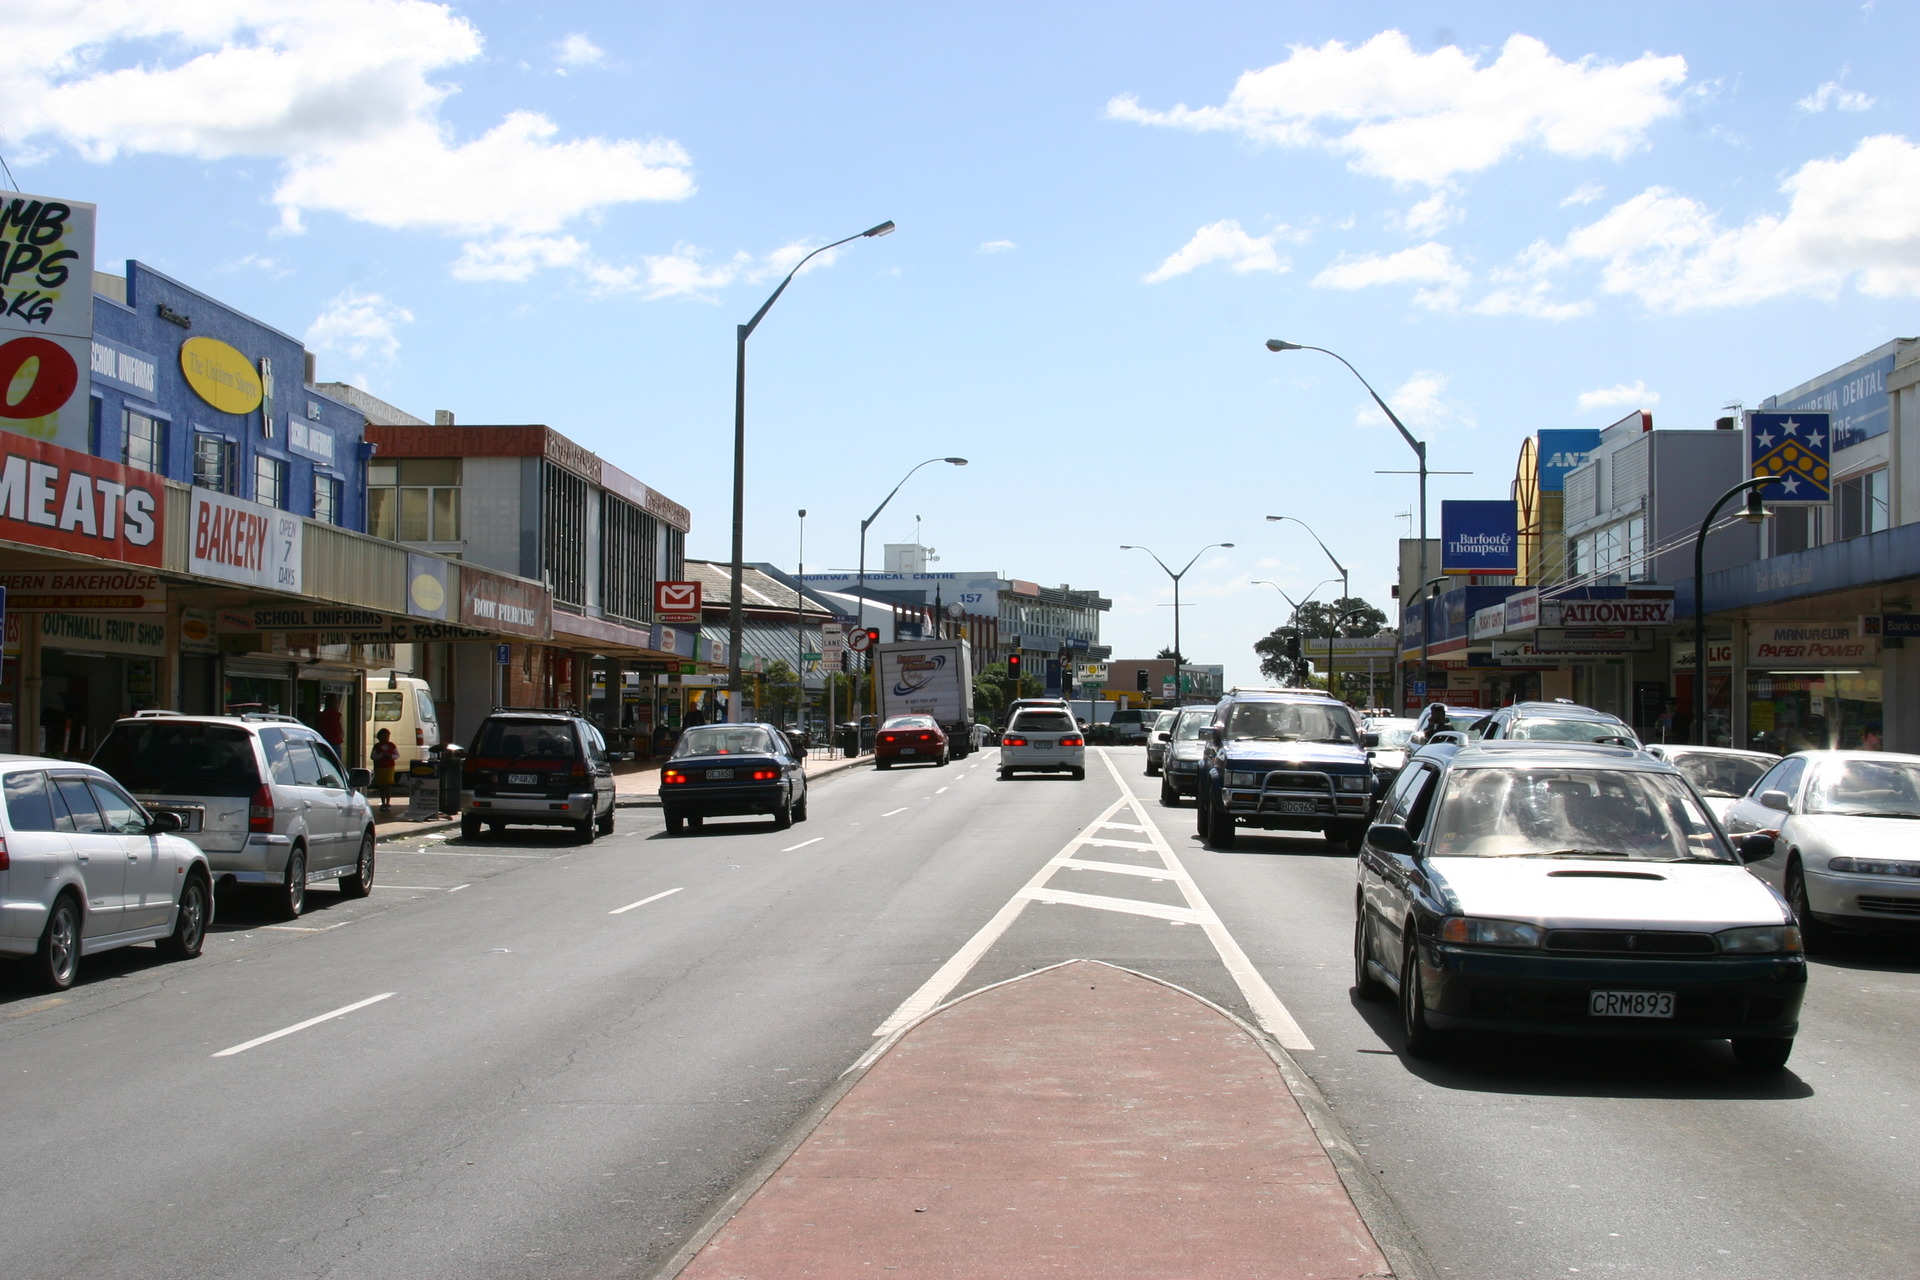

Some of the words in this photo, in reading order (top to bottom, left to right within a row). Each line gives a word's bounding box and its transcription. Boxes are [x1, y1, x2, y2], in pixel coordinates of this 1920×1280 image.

[91, 341, 116, 379] SCHOOL
[118, 352, 155, 392] UNIFORMS
[1843, 369, 1883, 407] DENTAL
[291, 421, 308, 449] SCHOOL
[309, 427, 333, 459] UNIFORMS
[194, 501, 269, 571] BAKERY
[278, 518, 296, 538] OPEN
[283, 541, 292, 562] 7
[1449, 541, 1509, 556] Thompson
[52, 575, 158, 590] BAKEHOUSE
[278, 566, 295, 586] DAYS
[856, 573, 905, 581] MEDICAL
[912, 572, 956, 580] CENTRE
[10, 597, 53, 607] BREAD
[74, 597, 133, 607] LUNCHES
[960, 593, 982, 602] 157
[254, 610, 307, 626] SCHOOL
[313, 609, 383, 625] UNIFORMS
[474, 598, 497, 619] BODY
[498, 603, 535, 627] PIERCING
[1558, 603, 1670, 623] ATIONERY
[41, 612, 102, 640] OUTHMALL
[106, 619, 135, 643] FRUIT
[137, 623, 165, 646] SHOP
[1773, 628, 1850, 641] MANUREWA
[1888, 620, 1911, 631] Bank
[1757, 643, 1806, 657] PAPER
[1807, 643, 1865, 657] POWER
[1592, 994, 1672, 1015] CRM893
